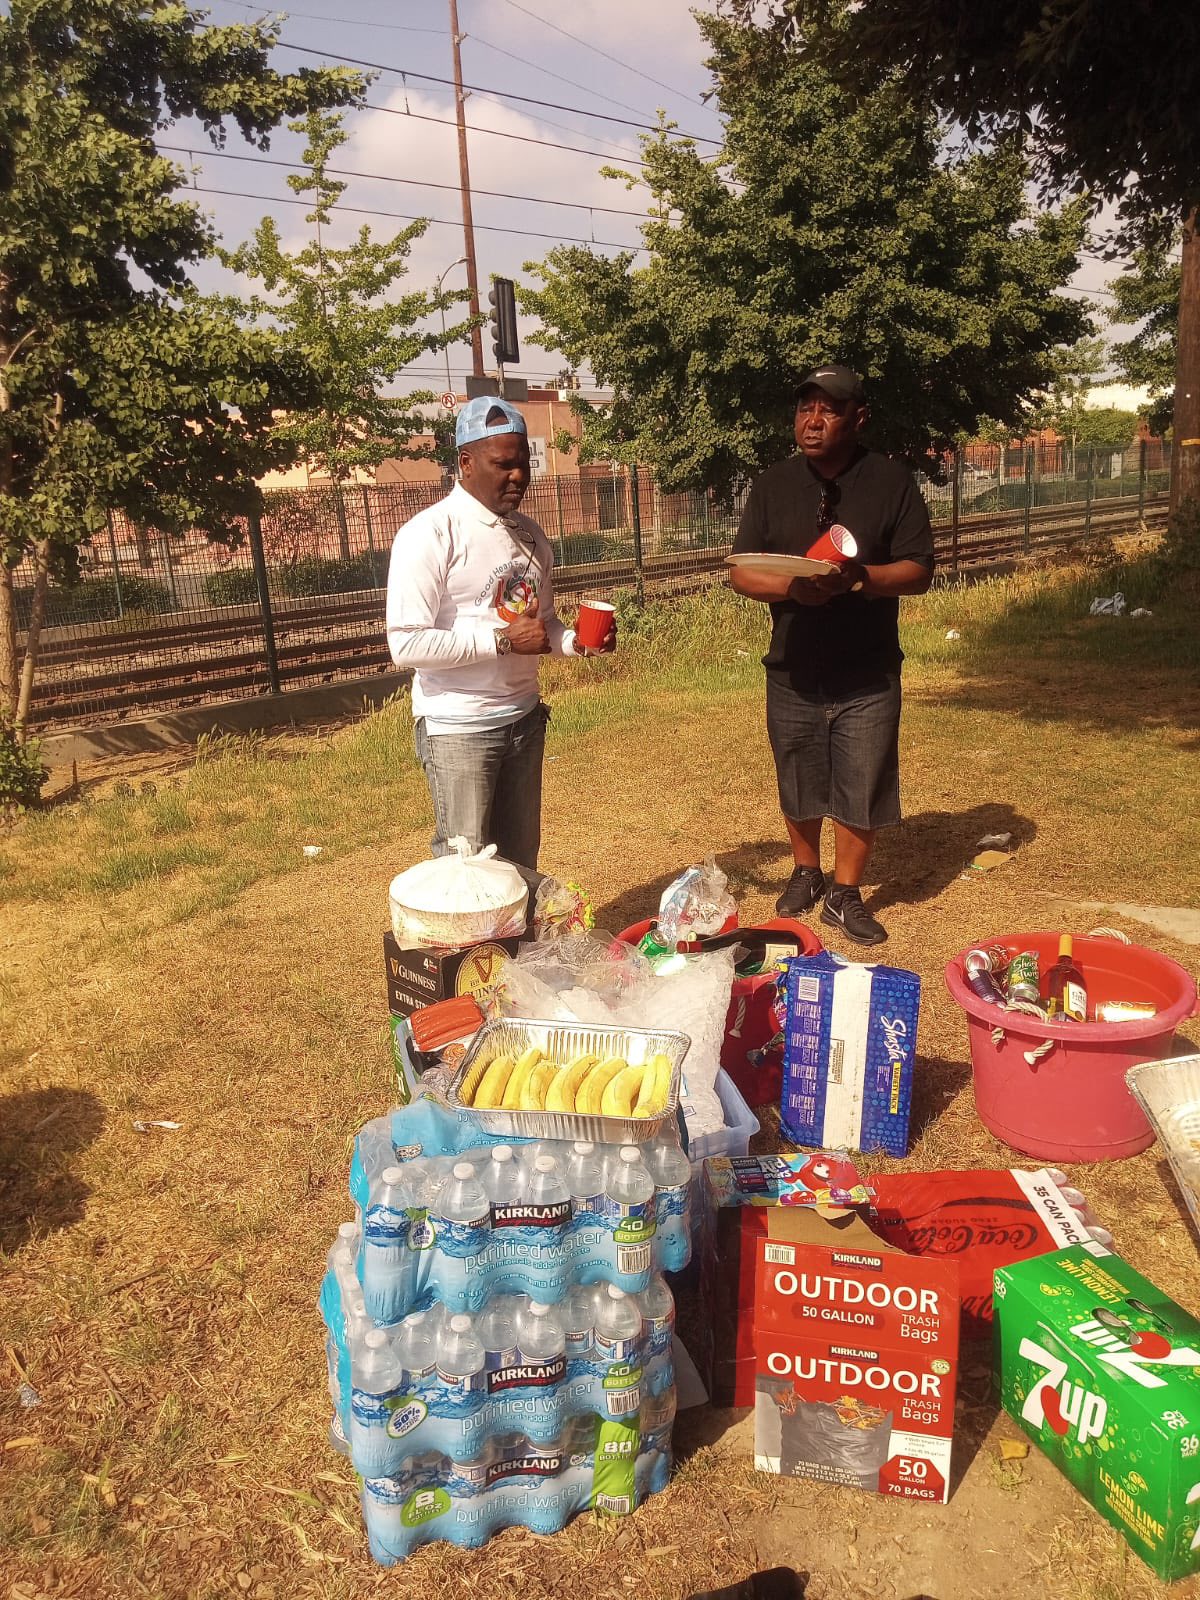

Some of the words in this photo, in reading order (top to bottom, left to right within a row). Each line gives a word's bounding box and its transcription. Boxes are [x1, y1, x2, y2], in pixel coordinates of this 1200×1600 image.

[474, 575, 495, 607] Good
[398, 964, 437, 992] GUINNESS
[395, 990, 415, 1009] EXTRA
[881, 1015, 907, 1063] Shasta
[495, 1204, 569, 1220] KIRKLAND
[1033, 1185, 1049, 1199] 35
[1043, 1198, 1065, 1222] CAN
[621, 1220, 643, 1231] 40
[464, 1240, 541, 1274] purified
[549, 1231, 603, 1259] water
[833, 1253, 881, 1267] KIRKLAND
[1055, 1259, 1087, 1278] LIME
[773, 1270, 939, 1315] OUTDOOR
[1080, 1277, 1122, 1304] LEMON
[802, 1305, 818, 1318] 50
[821, 1308, 875, 1326] GALLON
[901, 1314, 940, 1329] TRASH
[900, 1323, 939, 1343] Bags
[831, 1346, 878, 1360] KIRKLAND
[490, 1361, 564, 1385] KIRKLAND
[608, 1366, 630, 1377] 40
[767, 1352, 941, 1398] OUTDOOR
[1018, 1337, 1108, 1444] 7up
[462, 1397, 536, 1435] purified
[542, 1381, 595, 1412] water
[904, 1398, 941, 1412] TRASH
[393, 1407, 421, 1430] 50%
[902, 1407, 940, 1424] Bags
[604, 1441, 632, 1453] 80
[1180, 1434, 1199, 1452] 36
[489, 1458, 560, 1476] KIRKLAND
[898, 1458, 927, 1478] 50
[898, 1475, 926, 1485] GALLON
[416, 1491, 435, 1509] 8
[888, 1483, 902, 1493] 70
[904, 1487, 935, 1498] BAGS
[456, 1492, 528, 1523] purified
[1099, 1467, 1134, 1511] LEMON
[1137, 1505, 1165, 1541] LIME
